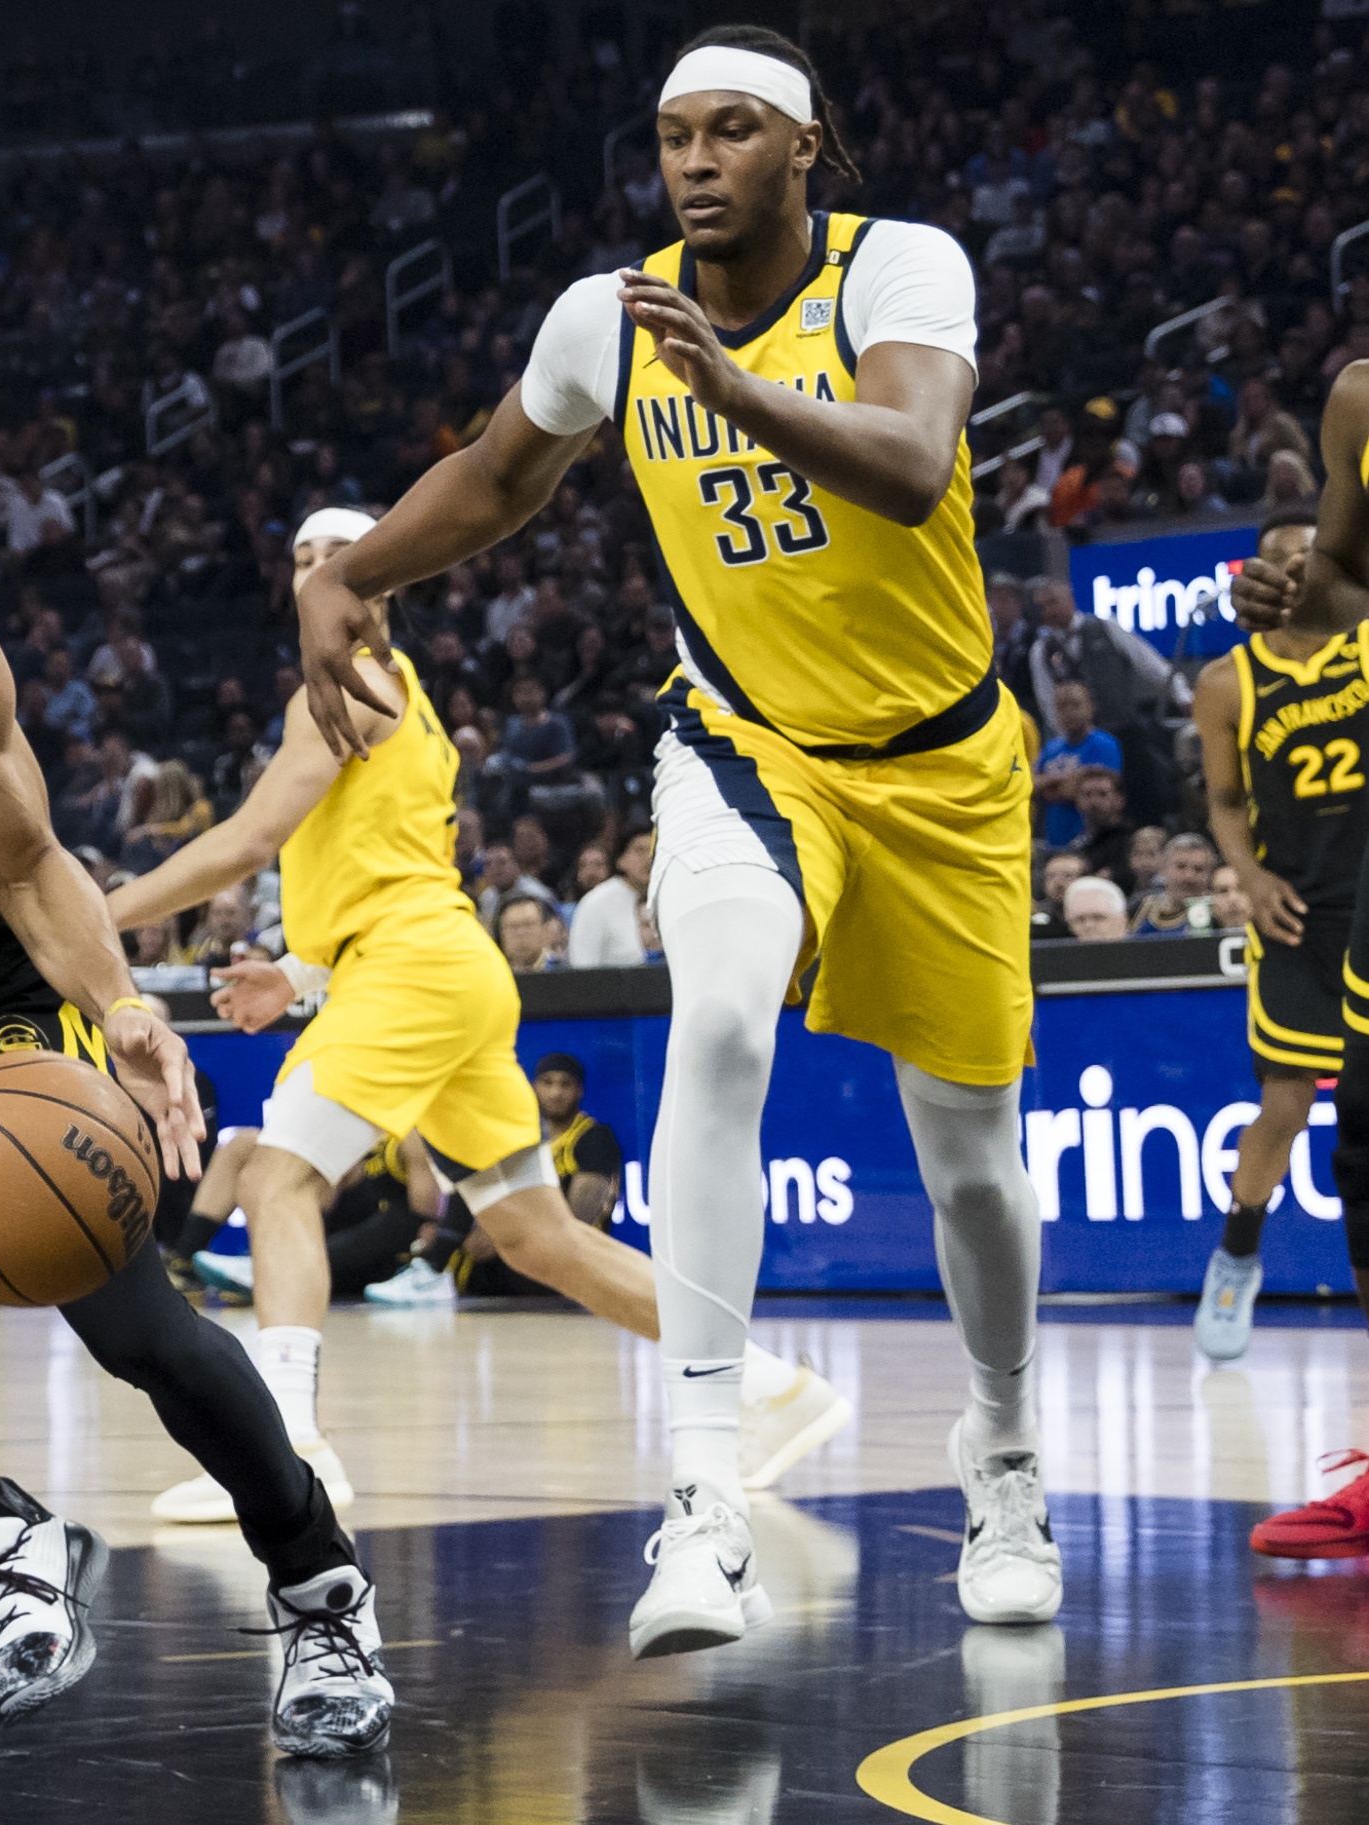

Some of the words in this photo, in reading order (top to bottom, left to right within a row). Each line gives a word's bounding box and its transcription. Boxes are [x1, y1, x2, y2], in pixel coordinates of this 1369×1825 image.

[698, 463, 830, 567] 33
[1288, 737, 1366, 799] 22
[1018, 1065, 1344, 1221] rinet
